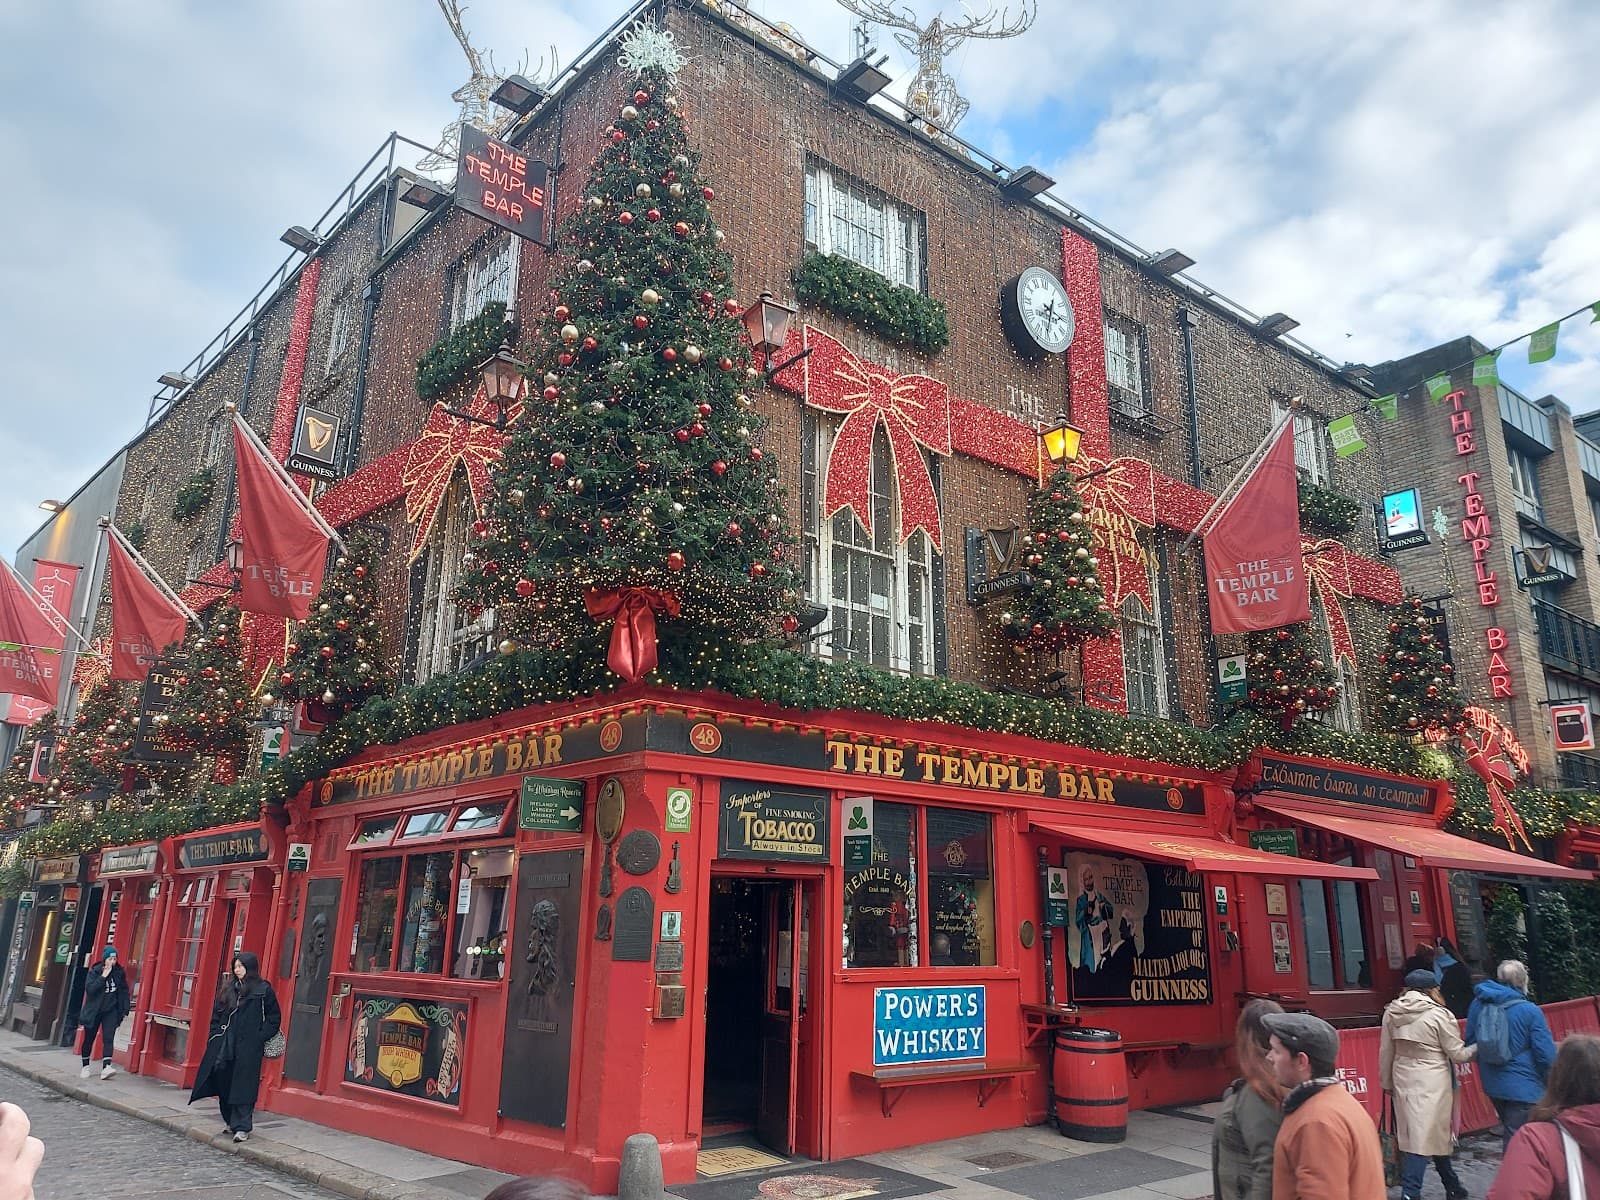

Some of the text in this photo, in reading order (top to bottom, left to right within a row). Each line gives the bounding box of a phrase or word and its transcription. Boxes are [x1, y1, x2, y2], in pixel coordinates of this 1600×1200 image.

[487, 141, 527, 176] THE
[466, 154, 544, 207] TEMPLE
[484, 190, 524, 222] BAR
[291, 459, 335, 478] GUINNESS
[1386, 534, 1426, 550] GUINNESS
[1445, 391, 1514, 699] THE TEMPLE BAR
[1237, 559, 1269, 575] THE
[977, 575, 1020, 595] GUINNESS
[1214, 567, 1295, 593] TEMPLE
[1523, 573, 1559, 586] GUINNESS
[1237, 588, 1280, 607] BAR
[16, 670, 39, 685] BAR
[603, 726, 619, 747] 48
[695, 727, 715, 747] 48
[1502, 727, 1529, 774] BAR
[354, 734, 564, 800] THE TEMPLE BAR
[826, 740, 1115, 804] THE TEMPLE BAR
[726, 790, 771, 811] Importers
[765, 807, 816, 820] FINE SMOKING
[738, 811, 816, 846] TOBACCO
[190, 836, 254, 861] THE TEMPLE BAR
[753, 840, 822, 853] Always in Stock
[873, 852, 889, 862] THE
[1111, 863, 1133, 878] THE
[844, 867, 891, 896] TEMPLE
[1102, 876, 1143, 893] TEMPLE
[1113, 890, 1135, 907] BAR
[1181, 891, 1201, 910] THE
[1160, 909, 1203, 929] EMPEROR
[1191, 929, 1202, 948] OF
[1133, 948, 1206, 977] MALTED LIQUORS
[1130, 979, 1208, 1001] GUINNESS
[884, 992, 978, 1021] POWER'S
[877, 1026, 984, 1057] WHISKEY
[1346, 1077, 1368, 1095] BAR
